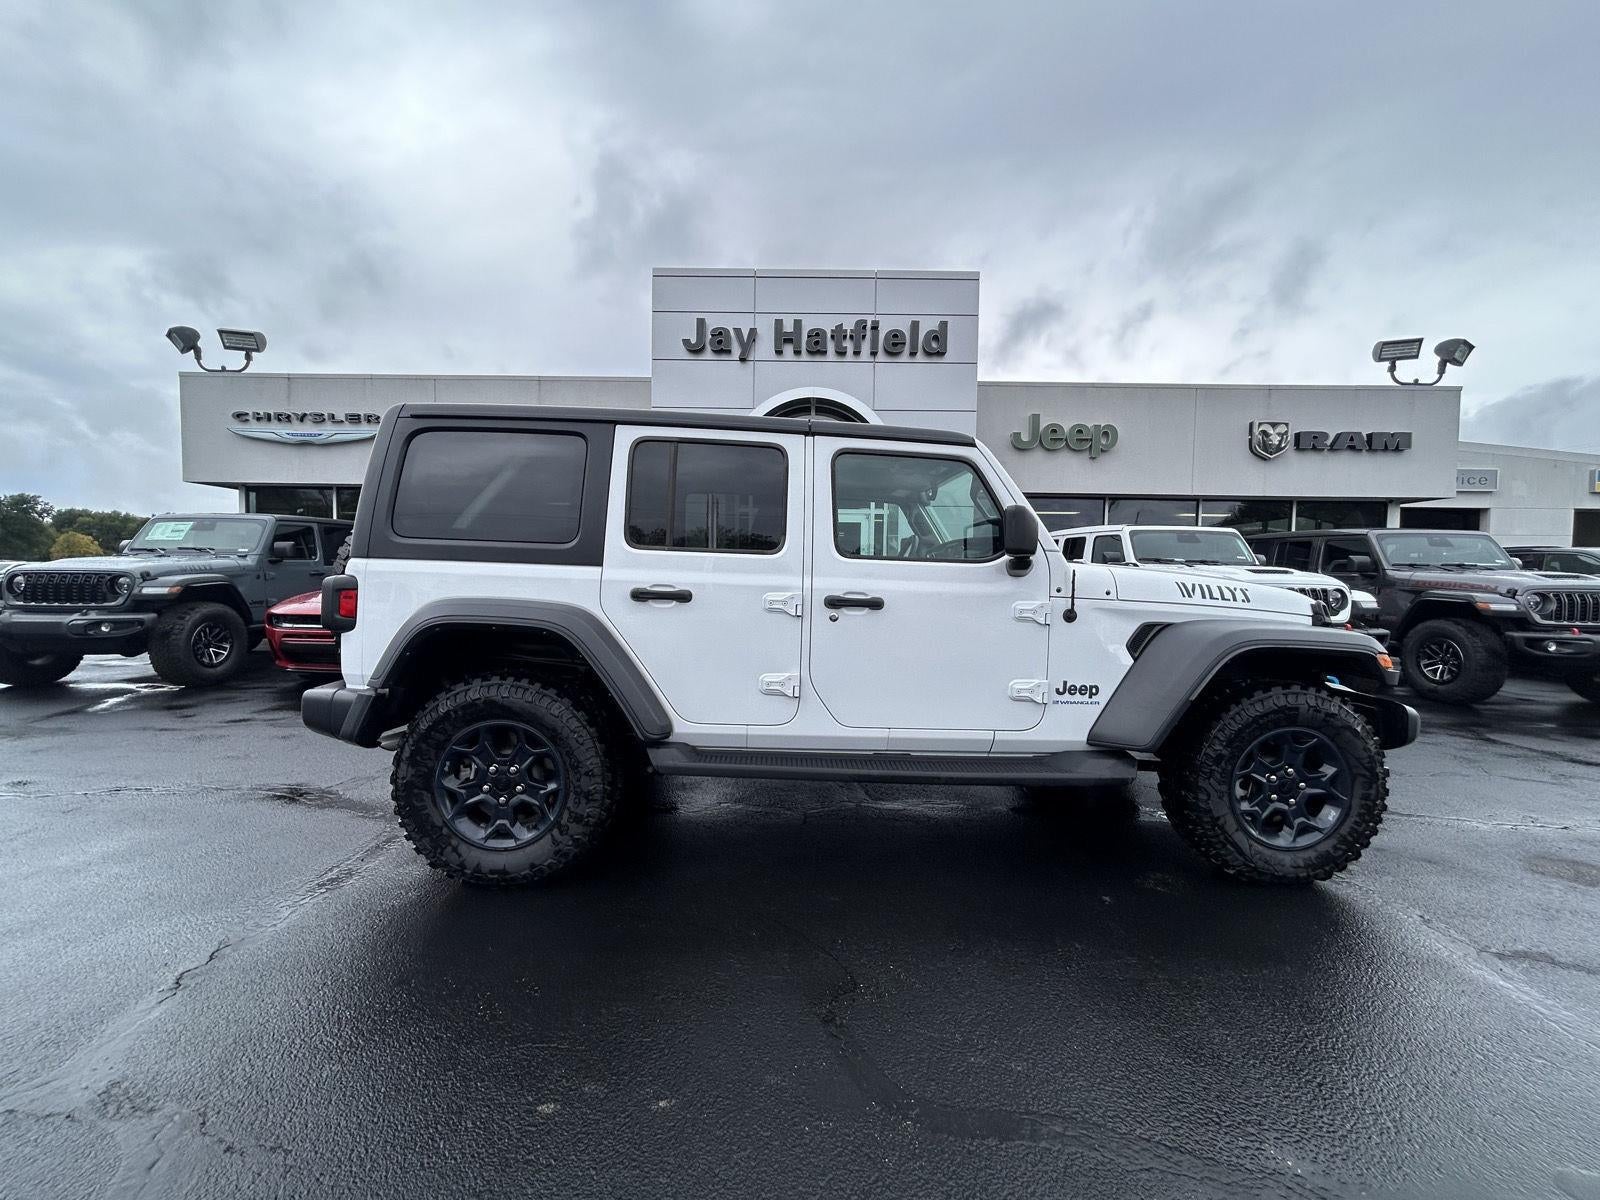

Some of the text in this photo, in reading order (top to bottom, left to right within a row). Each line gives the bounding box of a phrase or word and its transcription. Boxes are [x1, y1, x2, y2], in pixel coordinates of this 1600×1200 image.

[682, 317, 949, 361] Jay Hatfield
[231, 411, 381, 424] CHRYSLER
[1010, 413, 1119, 458] Jeep
[1294, 430, 1413, 451] RAM
[1456, 472, 1488, 486] ice
[1175, 581, 1251, 603] WILLYS
[1055, 680, 1100, 699] Jeep
